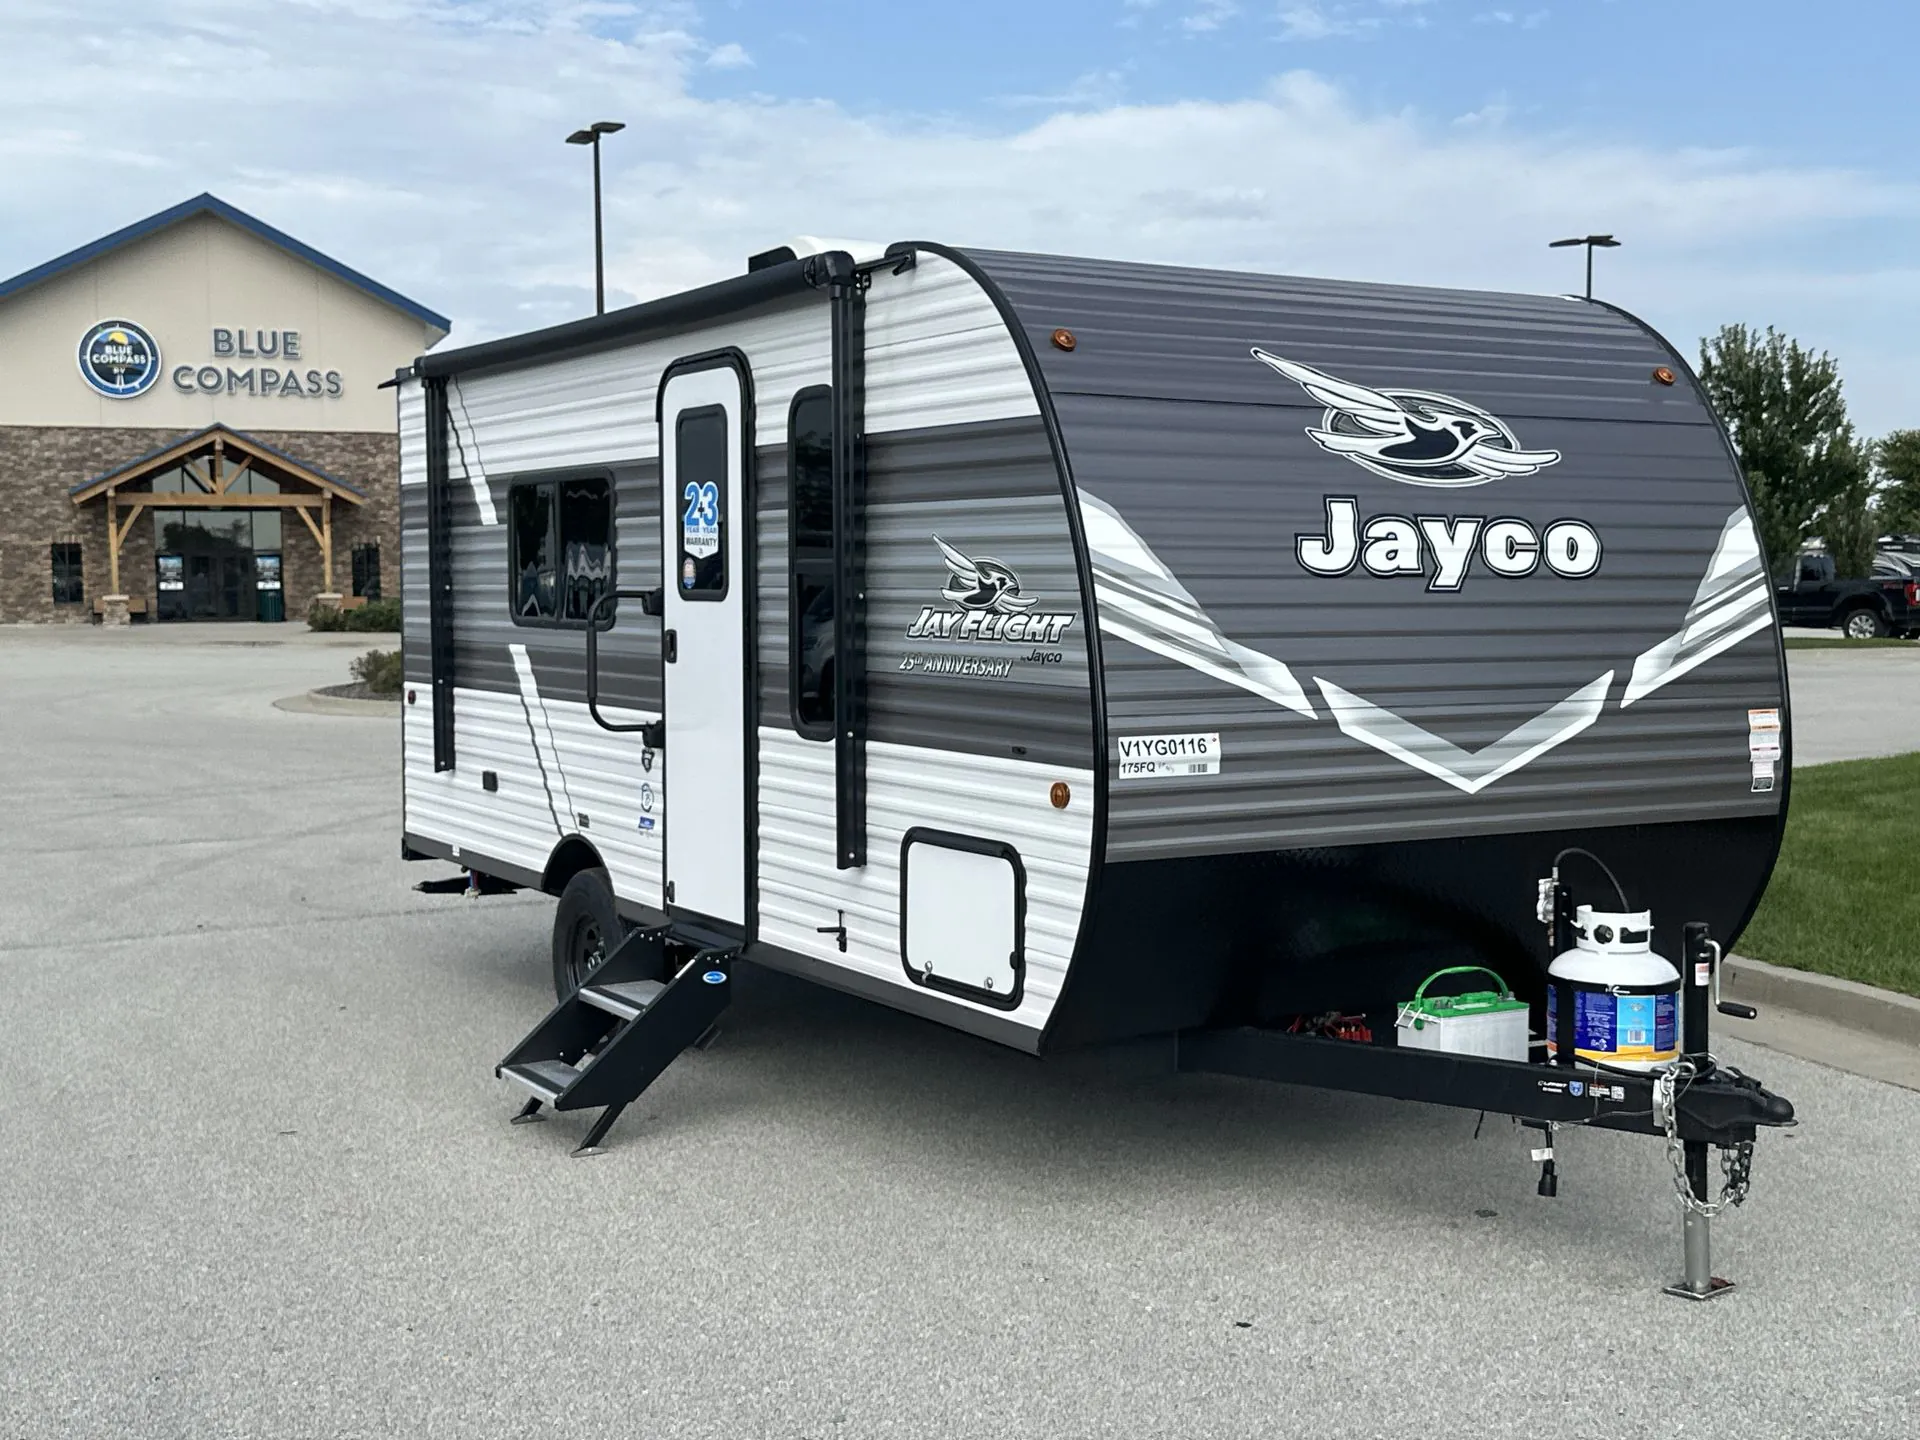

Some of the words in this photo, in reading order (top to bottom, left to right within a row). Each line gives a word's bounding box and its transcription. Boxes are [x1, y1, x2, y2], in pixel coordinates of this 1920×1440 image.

[104, 345, 133, 355] BLUE
[212, 327, 301, 359] BLUE
[92, 354, 146, 364] COMPASS
[172, 365, 344, 398] COMPASS
[686, 536, 718, 547] WARRANTY
[1294, 494, 1604, 593] Jayco
[906, 604, 965, 641] JAY
[957, 608, 1077, 645] FLIGHT
[1026, 648, 1063, 665] Jayco
[923, 655, 1013, 679] ANNIVERSARY
[1120, 738, 1207, 757] V1YG0116
[1121, 761, 1156, 774] 175FQ
